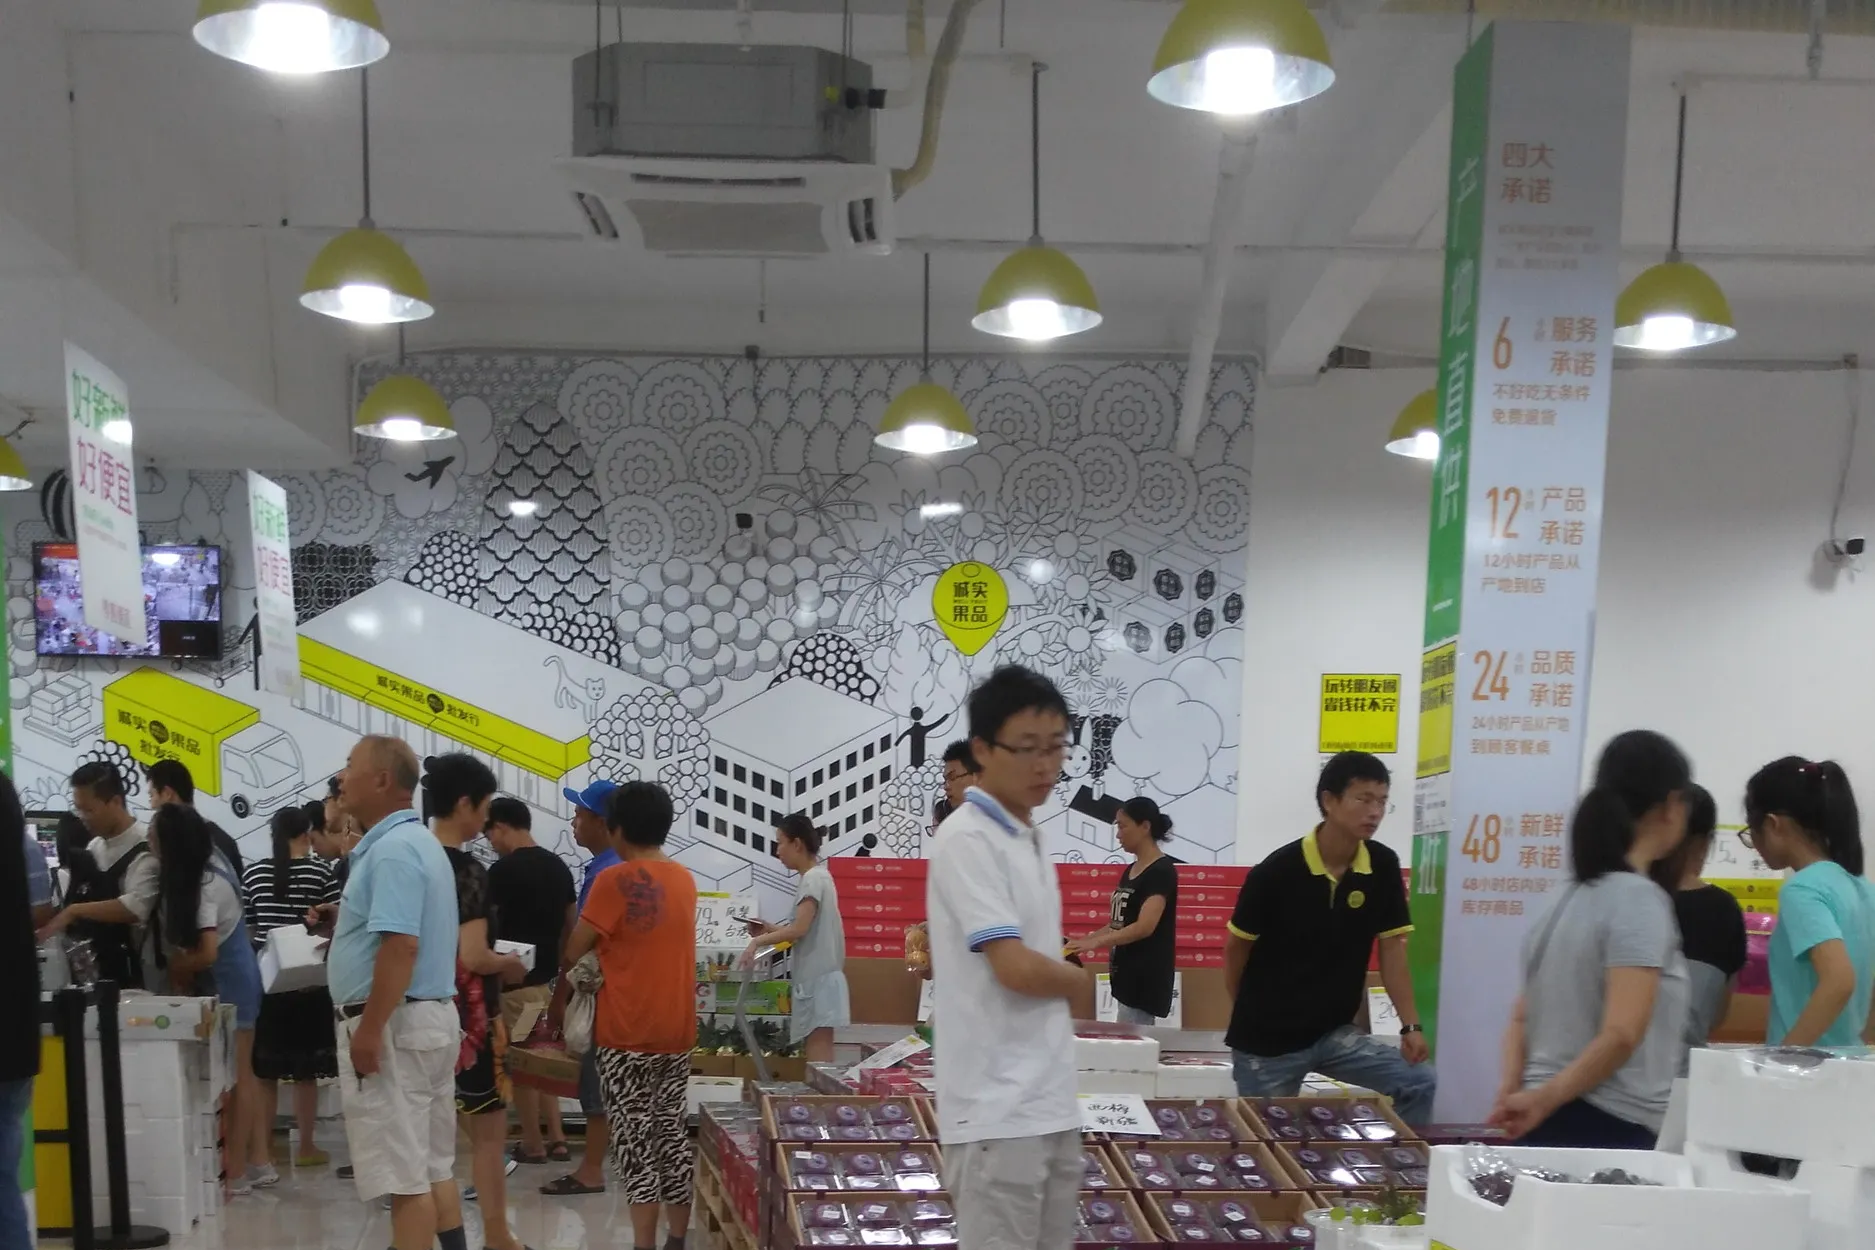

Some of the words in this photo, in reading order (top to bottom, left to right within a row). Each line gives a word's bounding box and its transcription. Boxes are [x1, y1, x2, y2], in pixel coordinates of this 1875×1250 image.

[1502, 142, 1554, 169] 四大
[1501, 177, 1552, 204] 承诺
[1493, 316, 1512, 370] 6
[1552, 316, 1597, 342] 服务
[1550, 350, 1596, 377] 承诺
[1492, 383, 1590, 401] 不好吃无条件
[1485, 486, 1520, 539] 12
[1540, 486, 1585, 512] 产品
[1539, 520, 1585, 546] 承诺
[1484, 553, 1580, 570] 12小时产品从
[1481, 577, 1547, 595] 产地到店
[953, 605, 988, 623] 果品
[1472, 650, 1510, 701] 24
[1531, 650, 1576, 676] 品质
[1529, 682, 1574, 708] 承诺
[1472, 715, 1569, 732] 24小时产品从产地
[1461, 813, 1501, 863] 48
[1520, 813, 1565, 838] 新鲜
[1518, 845, 1562, 870] 承诺
[1462, 876, 1556, 893] 48小时店内没
[1461, 899, 1525, 915] 库存商品
